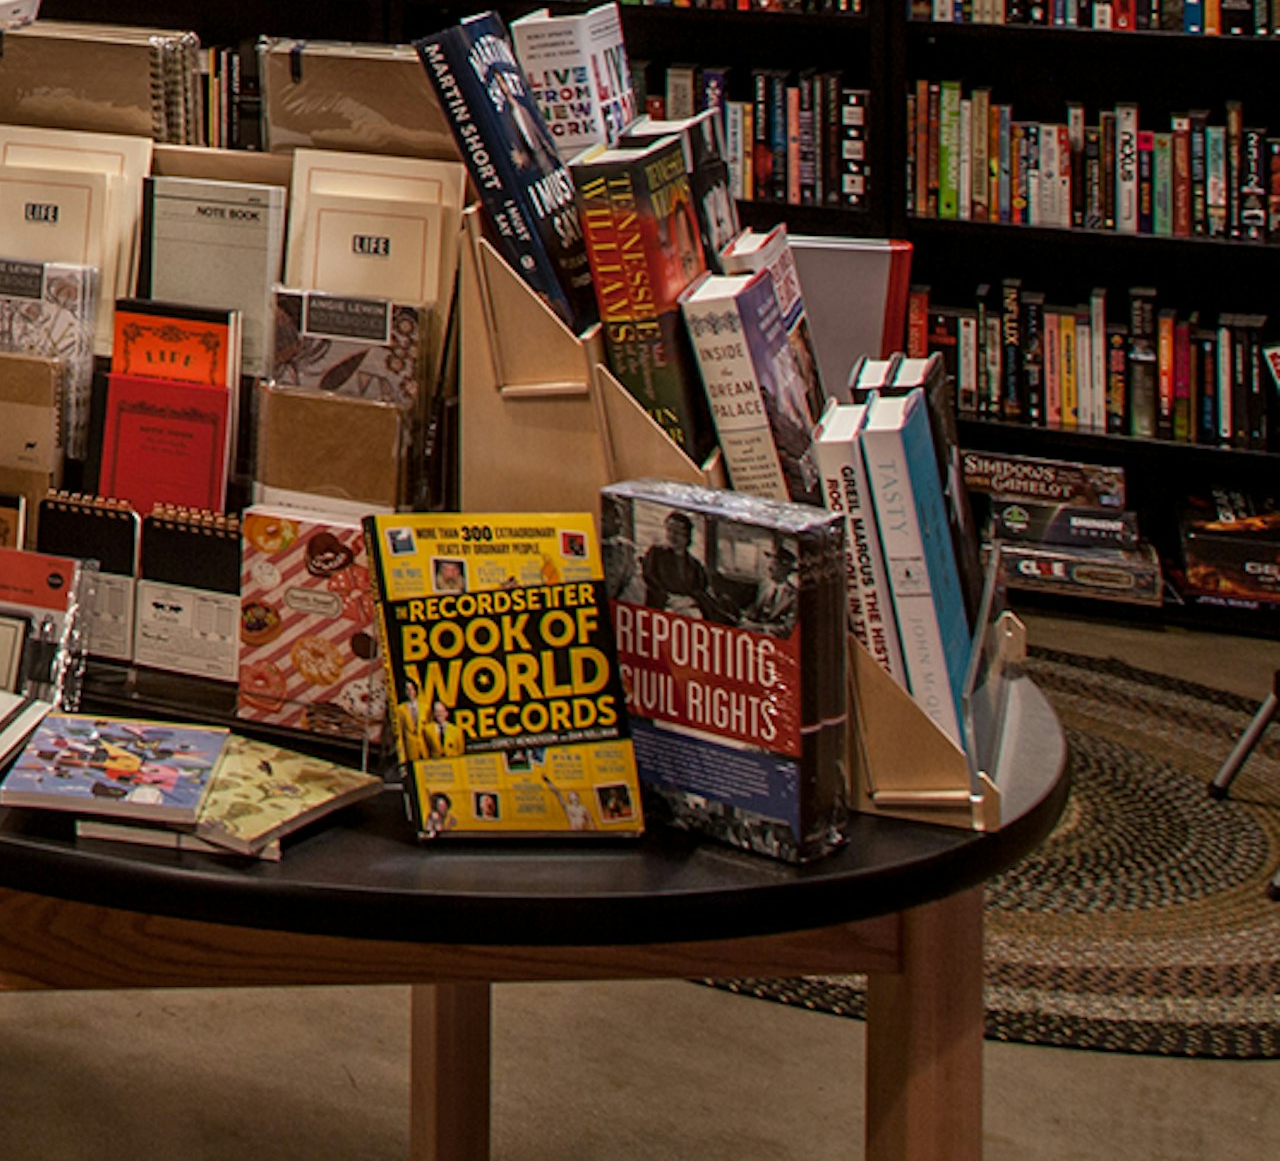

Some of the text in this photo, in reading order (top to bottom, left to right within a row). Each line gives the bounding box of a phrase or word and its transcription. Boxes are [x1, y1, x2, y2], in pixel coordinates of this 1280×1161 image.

[528, 66, 588, 88] LIVE
[533, 86, 591, 103] FROM
[424, 42, 503, 190] MARTIN SHORT
[543, 101, 591, 121] NEW
[547, 119, 597, 137] ORK
[534, 167, 575, 215] MUST
[26, 203, 59, 222] LIFE
[197, 206, 261, 221] NOTE BOOK
[507, 206, 532, 241] MUST
[495, 213, 513, 238] SAY
[354, 236, 389, 255] LIFE
[9, 261, 43, 275] LEWIN
[582, 176, 636, 345] WILLIAMS
[608, 172, 660, 344] TENNESSEE
[309, 299, 385, 316] ANGIE LEWIN
[1003, 288, 1020, 346] INFLUX
[146, 350, 191, 367] LIFE
[699, 342, 745, 363] INSIDE
[707, 379, 756, 399] DREAM
[713, 400, 763, 418] PALACE
[964, 454, 1058, 481] SHADOWS
[877, 460, 909, 536] TASTY
[991, 476, 1073, 498] CAMELOT
[416, 525, 556, 542] MORE THAN 300 EXTRAORDINARY
[840, 466, 882, 623] GREIL MARCUS THE
[437, 542, 539, 555] FEATS BY ORDINARY PEOPLE
[1018, 560, 1065, 577] CLUE
[408, 583, 596, 623] RECORDSETTER
[849, 597, 863, 616] IN
[401, 607, 599, 663] BOOK OF
[616, 604, 777, 688] REPORTING
[908, 617, 932, 665] JOHN
[403, 646, 611, 710] WORLD
[619, 663, 779, 742] CIVIL RIGHTS
[453, 695, 618, 739] RECORDS
